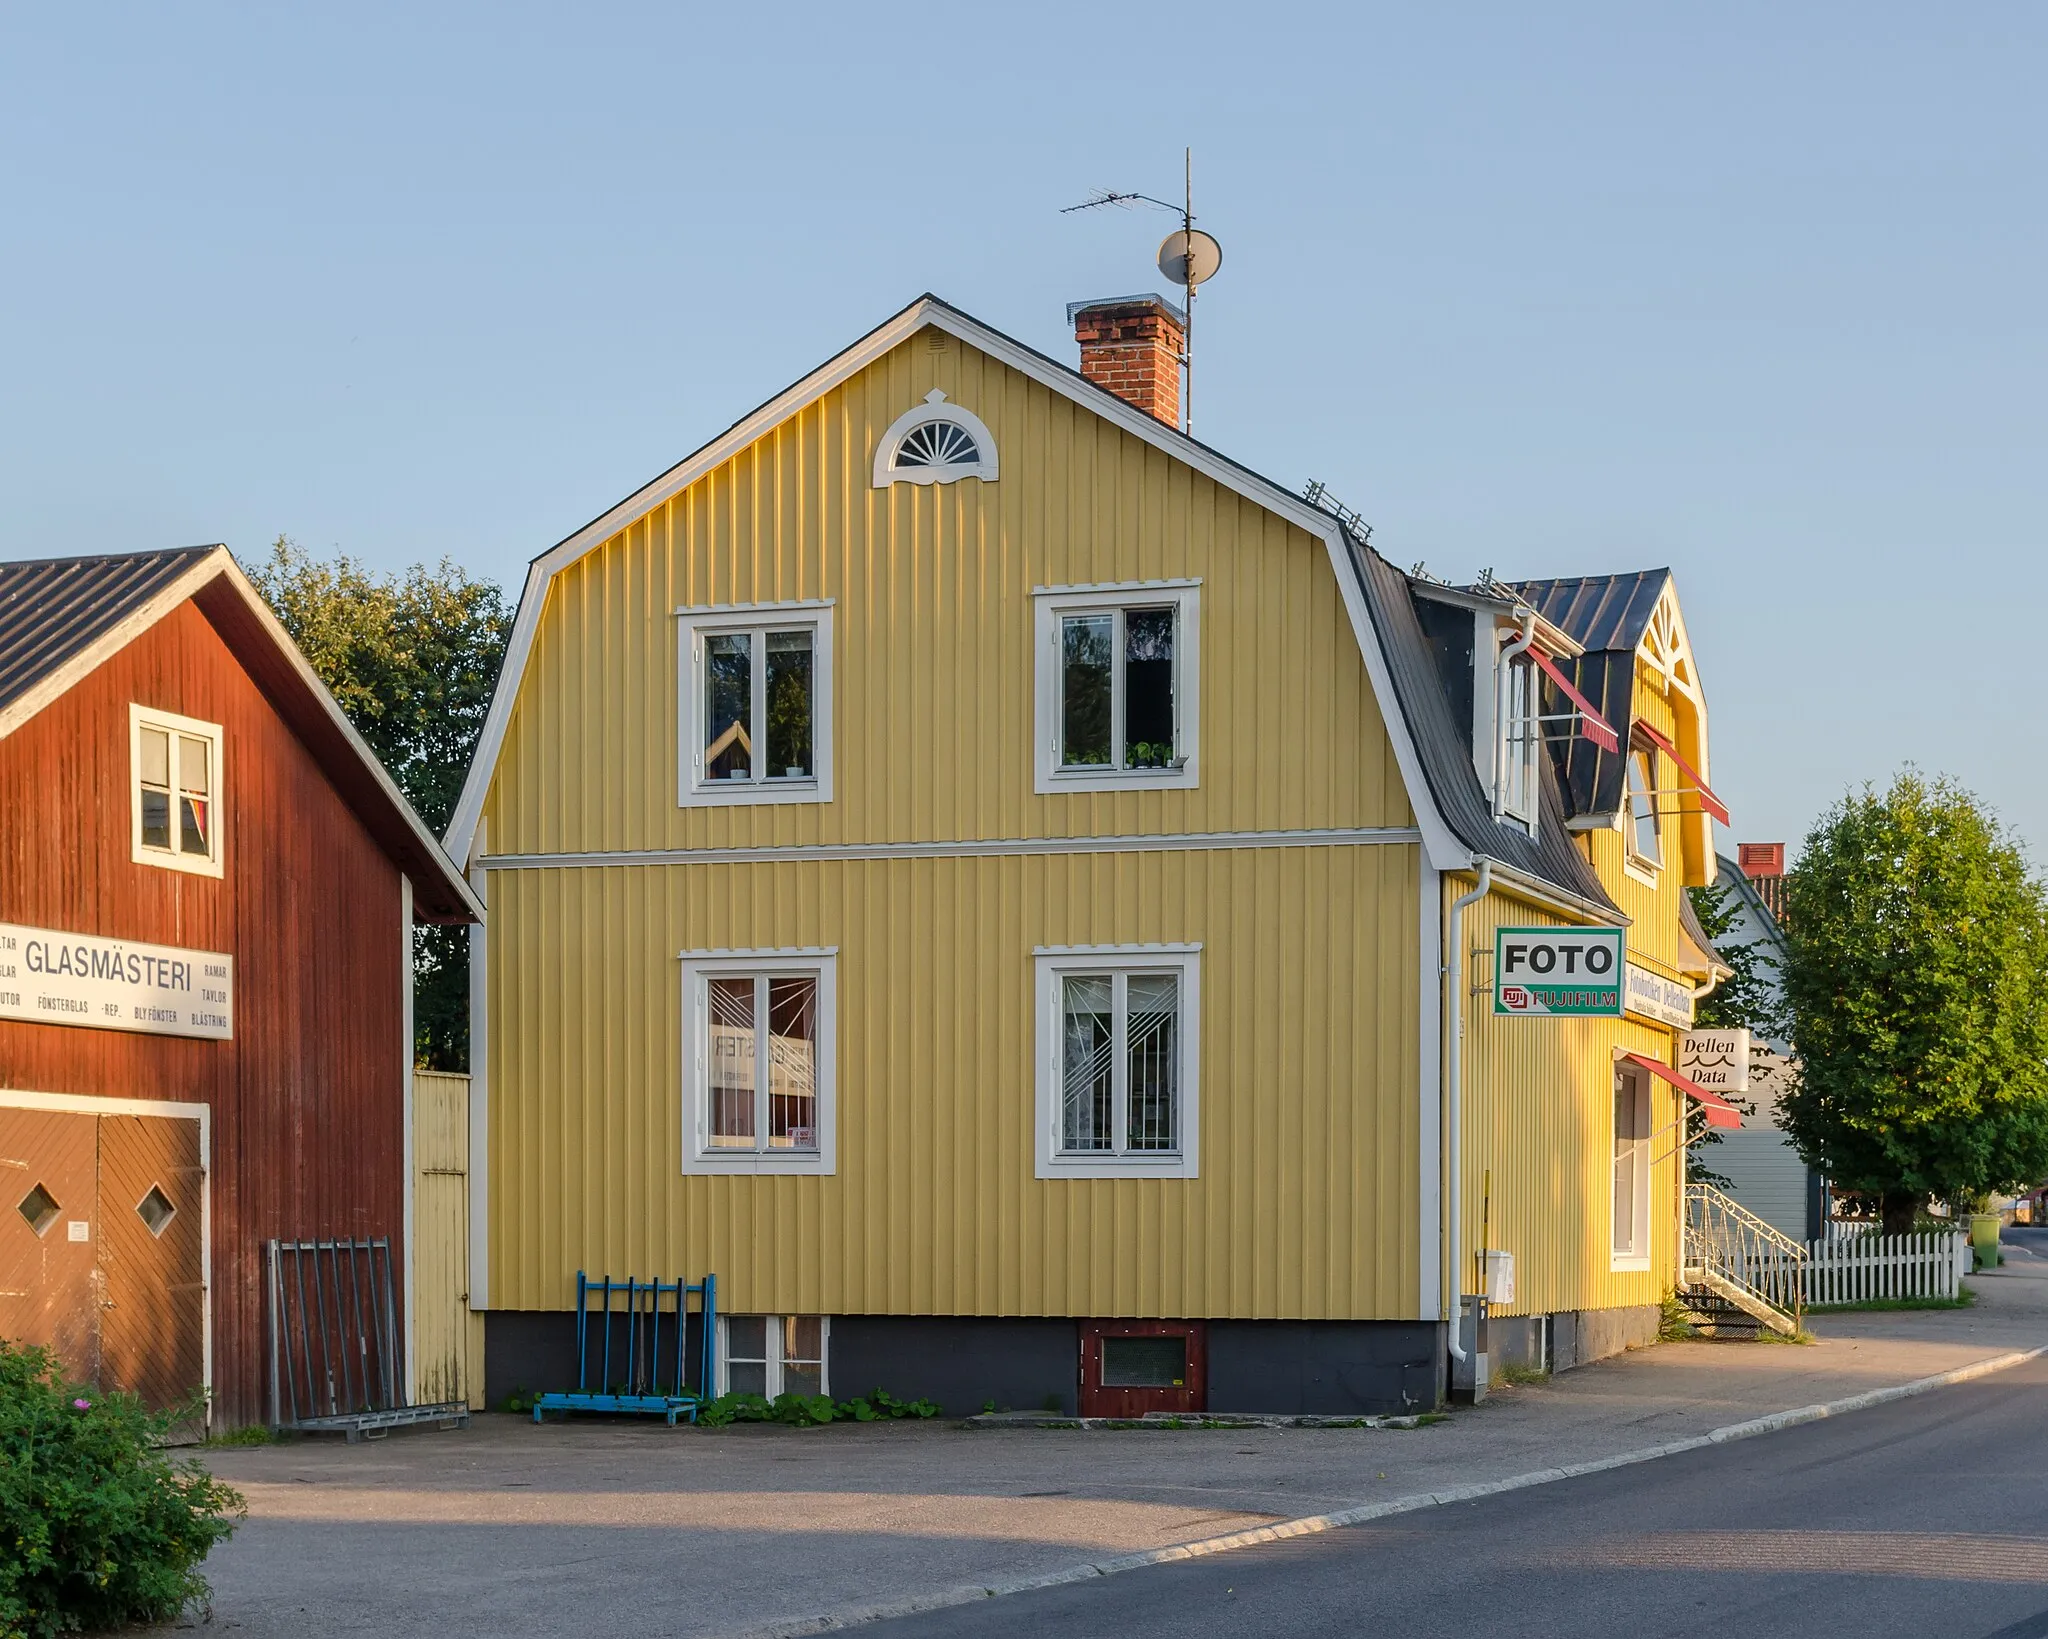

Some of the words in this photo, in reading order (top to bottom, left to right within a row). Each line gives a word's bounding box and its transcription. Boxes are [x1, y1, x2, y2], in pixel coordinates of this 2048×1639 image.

[0, 936, 16, 951] TAR
[25, 940, 191, 992] GLASMÄSTERI
[1505, 944, 1613, 974] FOTO
[204, 964, 227, 979] RAMAR
[38, 992, 89, 1013] FÖNSTERGLAS
[202, 988, 227, 1005] TAVLOR
[1533, 990, 1617, 1007] FUJIFILM
[1684, 1038, 1735, 1053] Dellen
[1691, 1069, 1726, 1083] Data
